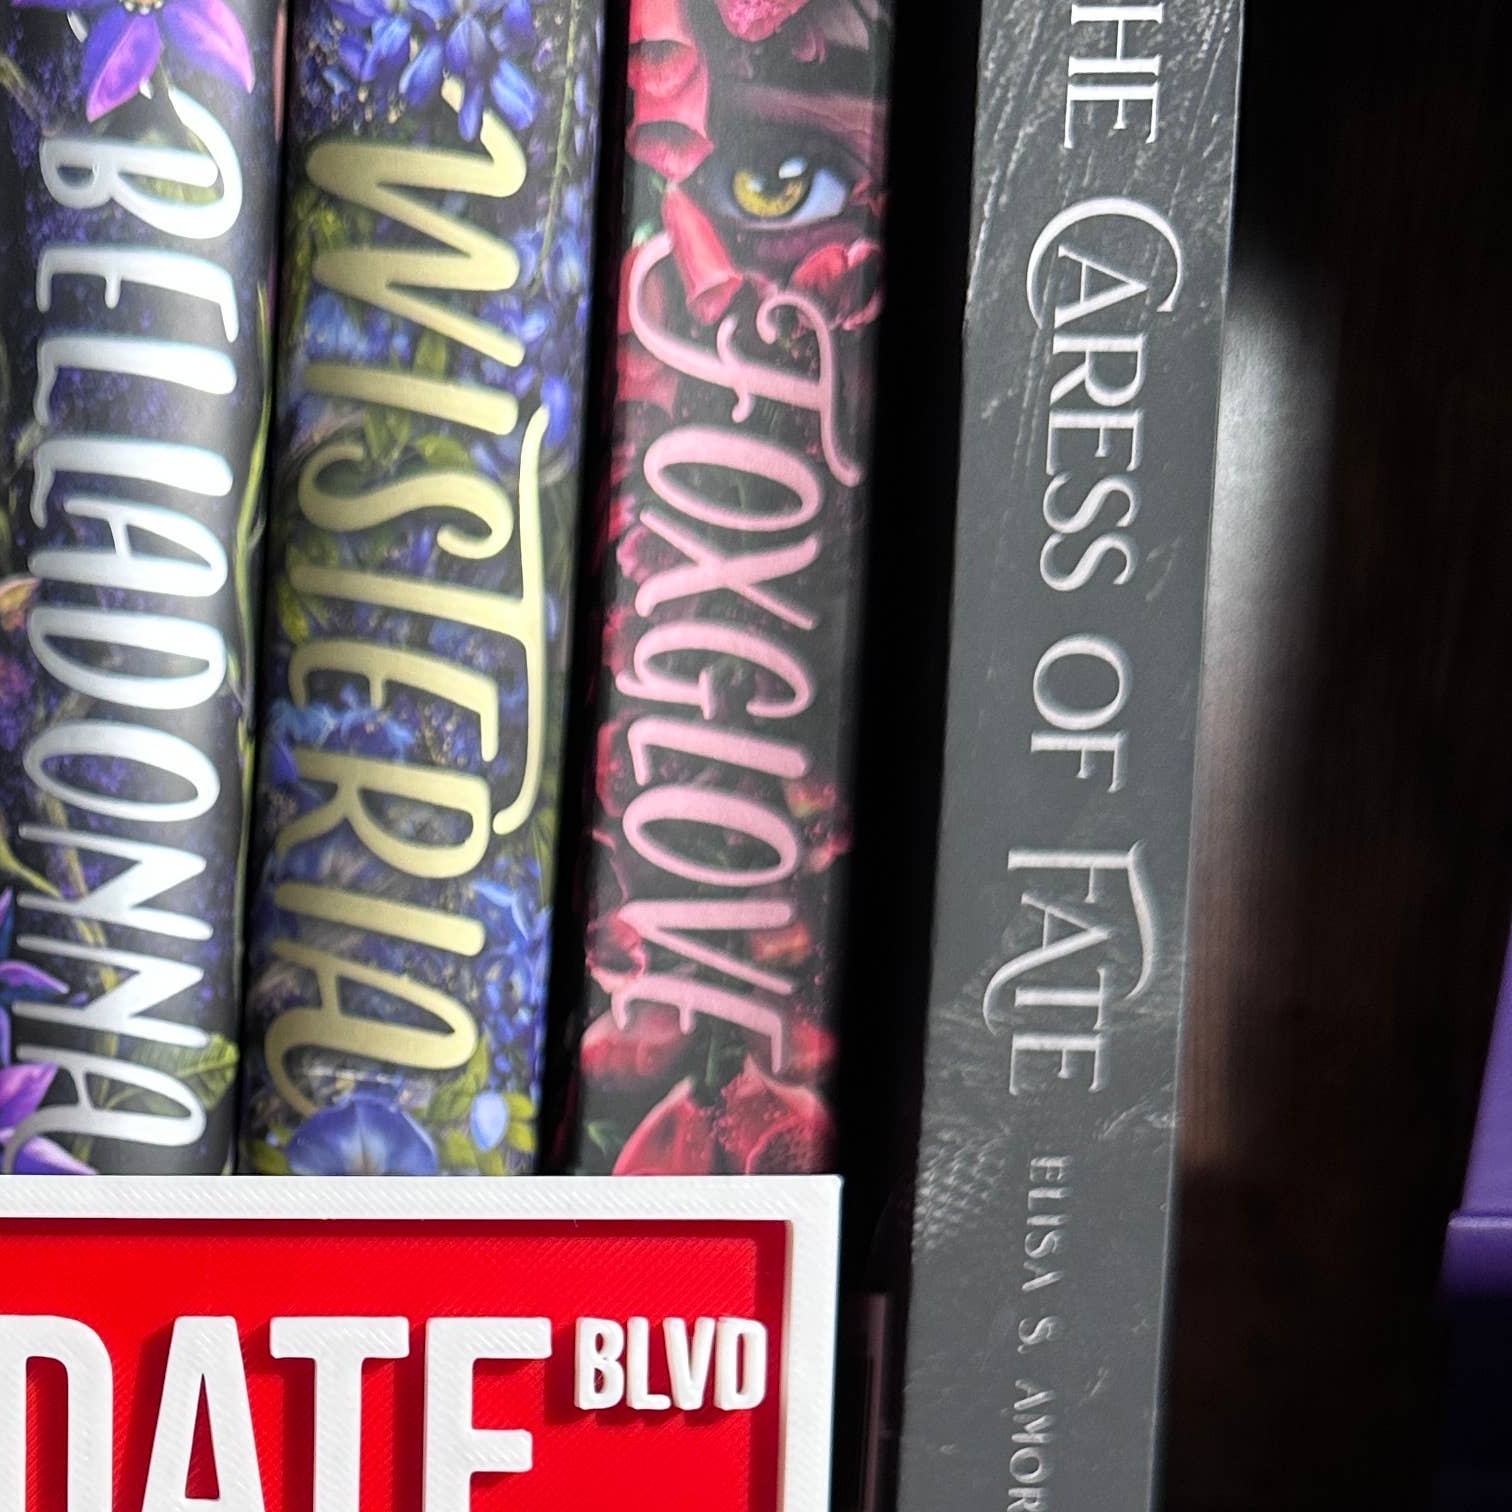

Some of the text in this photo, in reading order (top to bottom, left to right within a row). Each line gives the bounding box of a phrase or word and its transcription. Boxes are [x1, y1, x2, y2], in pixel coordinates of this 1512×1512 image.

[1027, 198, 1183, 591] CARESS
[5, 84, 243, 1172] BELLADONNA
[265, 111, 549, 1119] WISTERIA
[610, 231, 863, 1075] FOXGLOVE
[1030, 634, 1133, 793] OF
[984, 840, 1157, 1095] FATE
[574, 1315, 767, 1411] BLVD
[1021, 1155, 1074, 1292] ELISA
